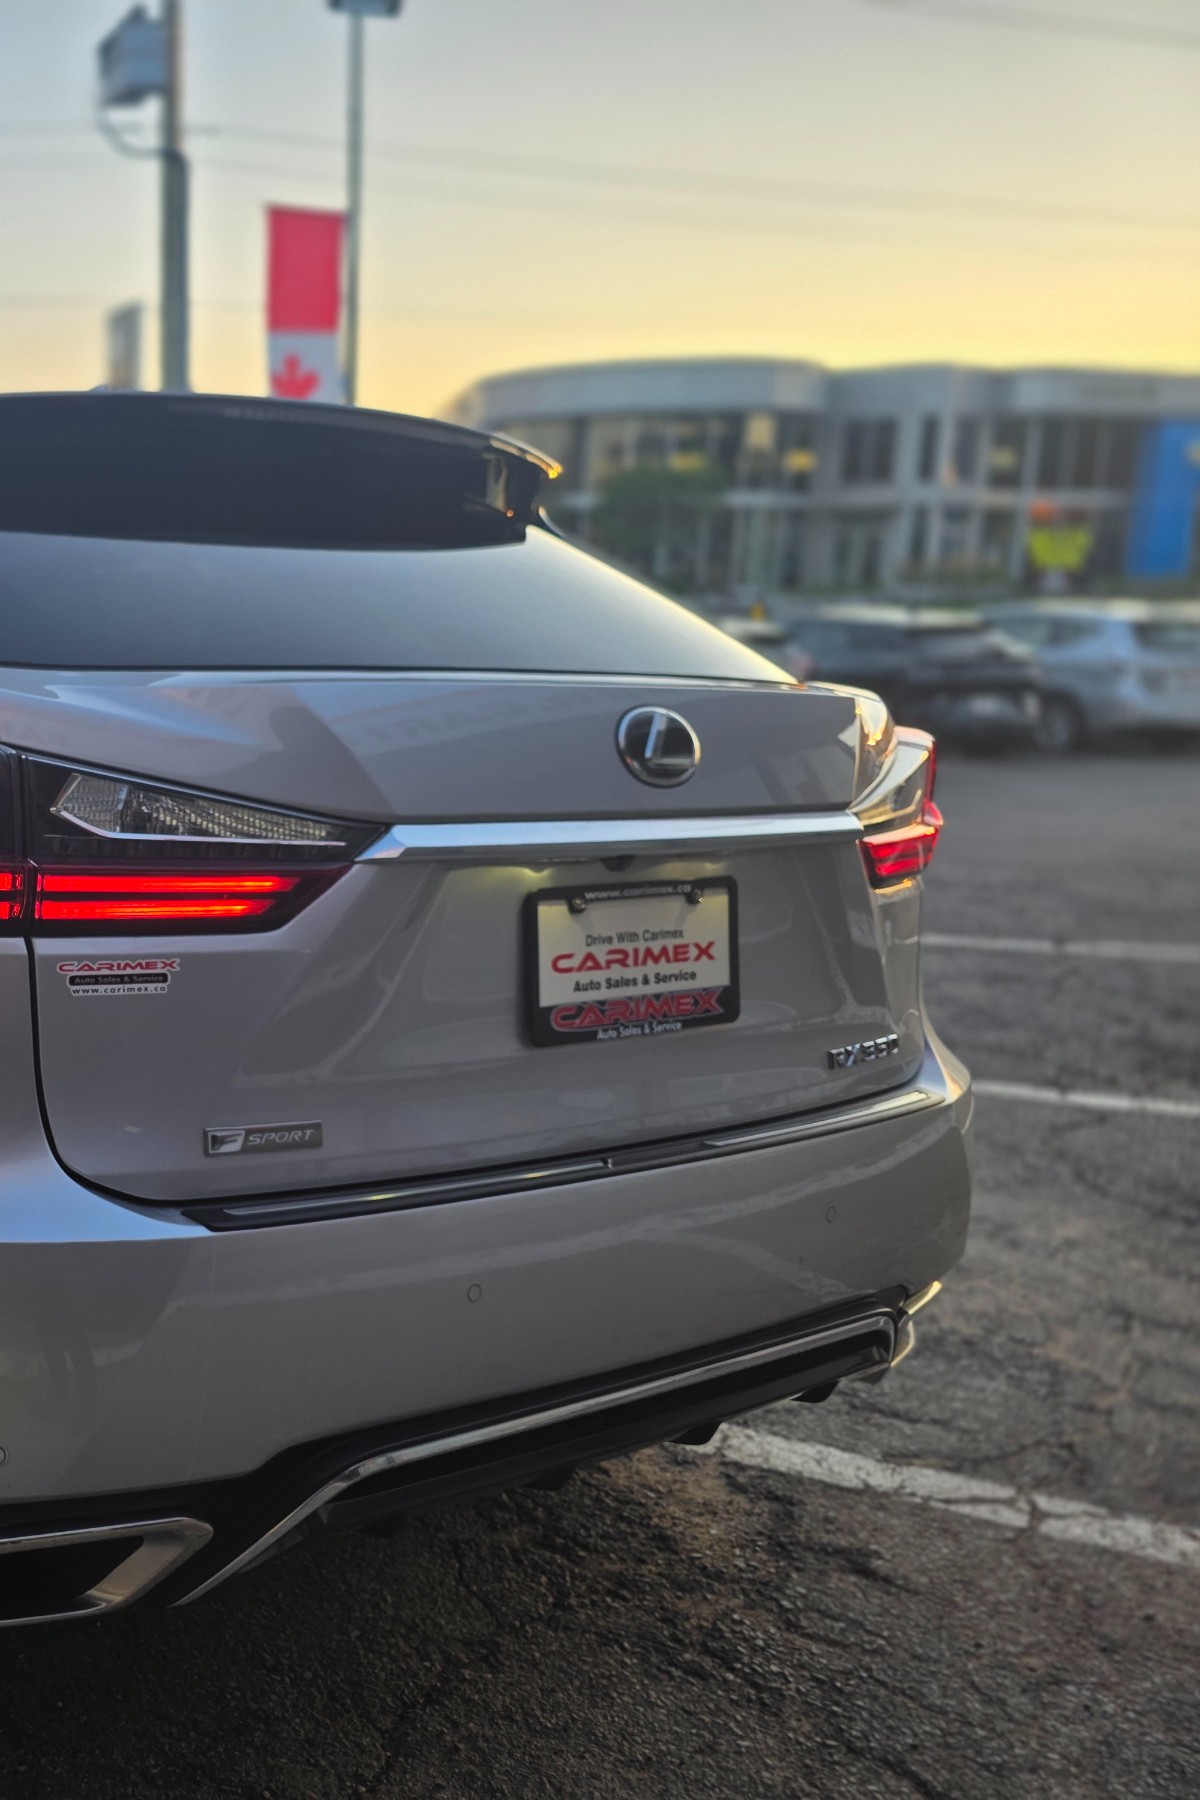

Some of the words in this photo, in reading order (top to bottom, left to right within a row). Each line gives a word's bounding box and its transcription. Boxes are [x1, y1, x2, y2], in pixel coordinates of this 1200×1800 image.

[585, 934, 613, 947] Drive
[616, 931, 639, 944] With
[642, 928, 684, 942] Carimex
[58, 960, 178, 972] CARIMEX
[551, 941, 716, 974] CARIMEX
[74, 977, 96, 985] Auto
[98, 976, 120, 984] Sales
[123, 975, 130, 983] &
[132, 974, 164, 983] Service
[573, 980, 601, 993] Auto
[605, 976, 638, 991] Sales
[641, 974, 650, 986] &
[654, 970, 696, 985] Service
[72, 985, 166, 995] www.carimex.ca
[552, 987, 723, 1031] CARIMEX
[597, 1027, 617, 1040] Auto
[619, 1023, 641, 1037] Sales
[643, 1023, 650, 1034] &
[652, 1020, 682, 1033] Service
[247, 1129, 316, 1146] SPORT
